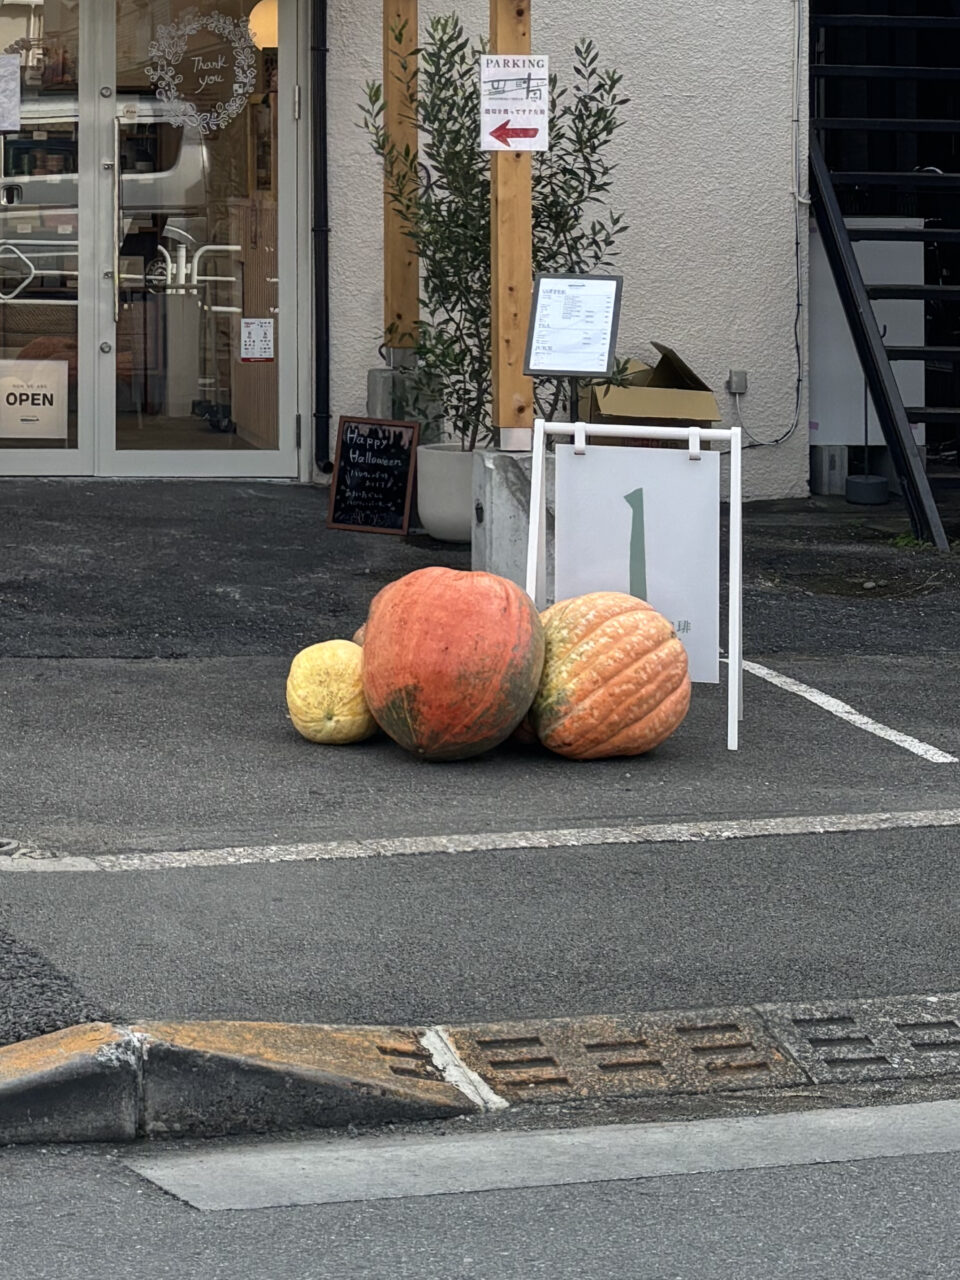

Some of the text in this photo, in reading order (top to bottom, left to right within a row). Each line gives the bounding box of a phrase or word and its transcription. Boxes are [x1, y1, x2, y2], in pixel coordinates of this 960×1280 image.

[191, 54, 230, 73] Thank
[486, 58, 545, 69] PARKING
[195, 75, 225, 94] you
[5, 392, 54, 407] OPEN
[346, 426, 388, 449] Happy
[349, 448, 402, 466] Halloween
